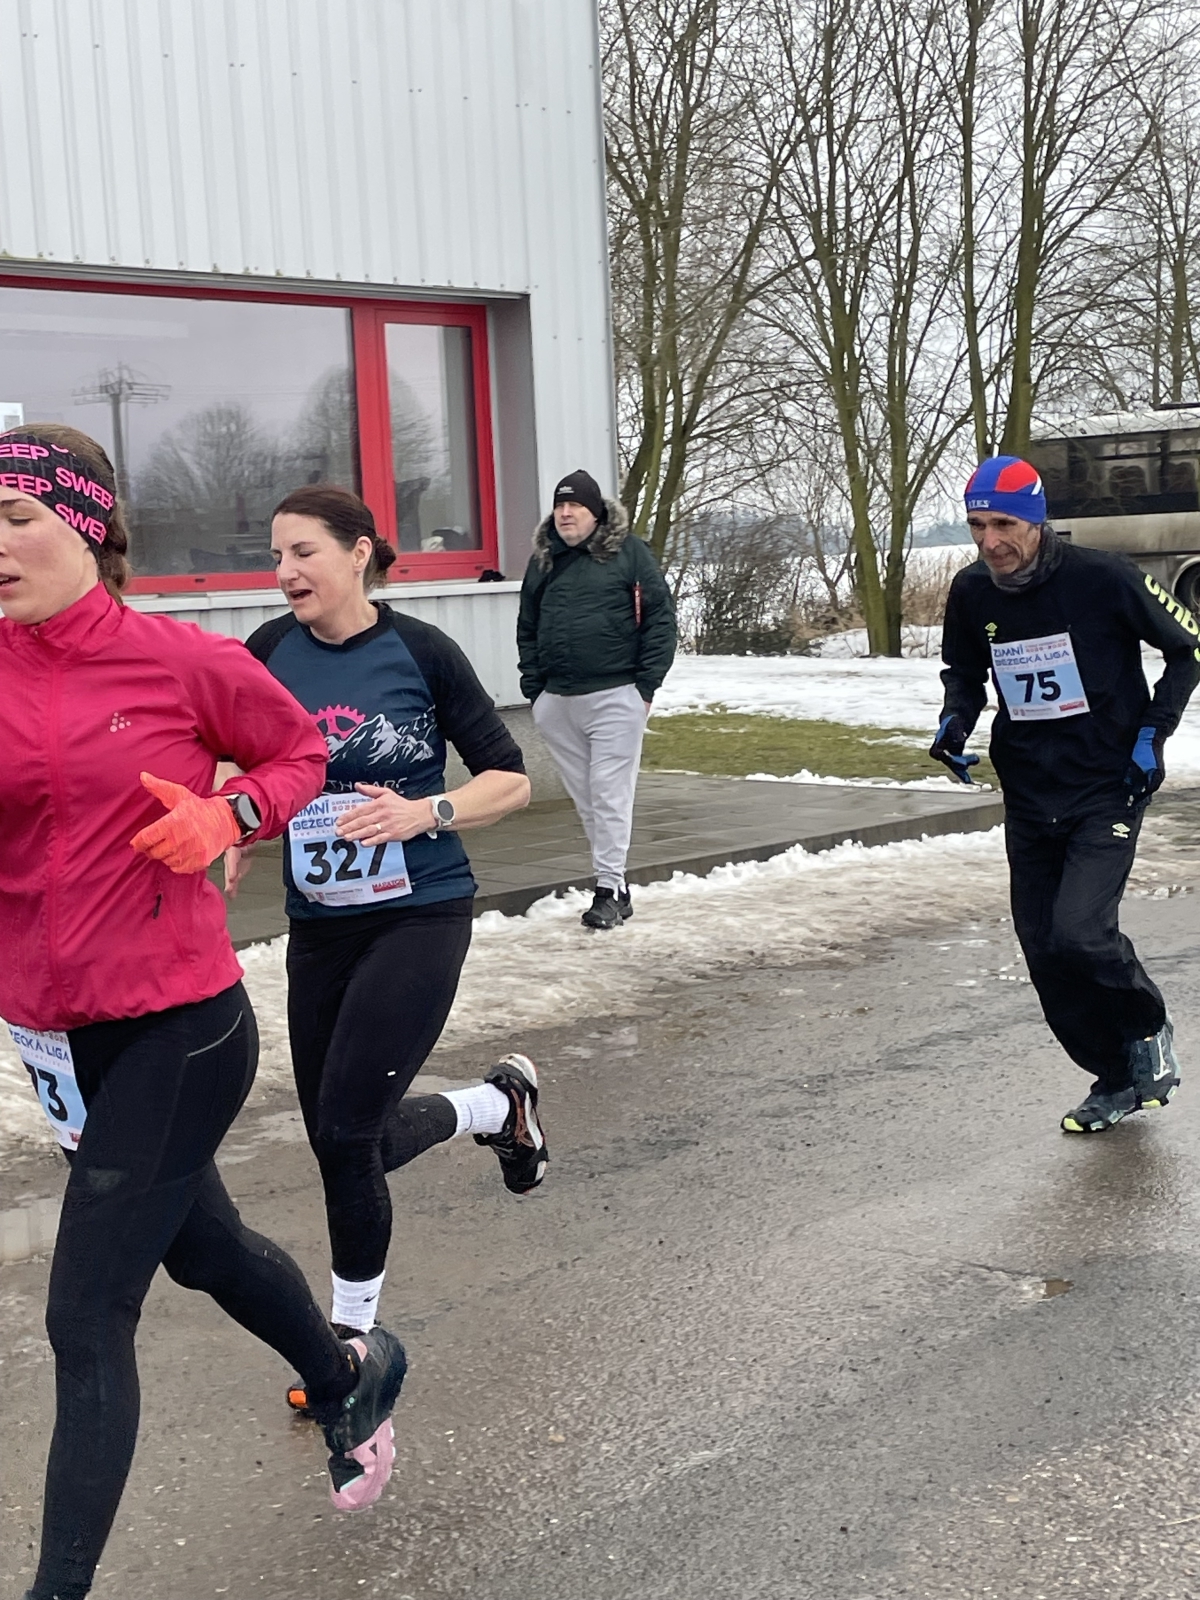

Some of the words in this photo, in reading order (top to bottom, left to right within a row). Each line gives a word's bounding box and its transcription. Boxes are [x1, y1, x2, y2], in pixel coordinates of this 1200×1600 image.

[1043, 650, 1070, 661] LIGA
[1015, 669, 1061, 703] 75
[303, 838, 388, 885] 327
[45, 1043, 70, 1064] LIGA
